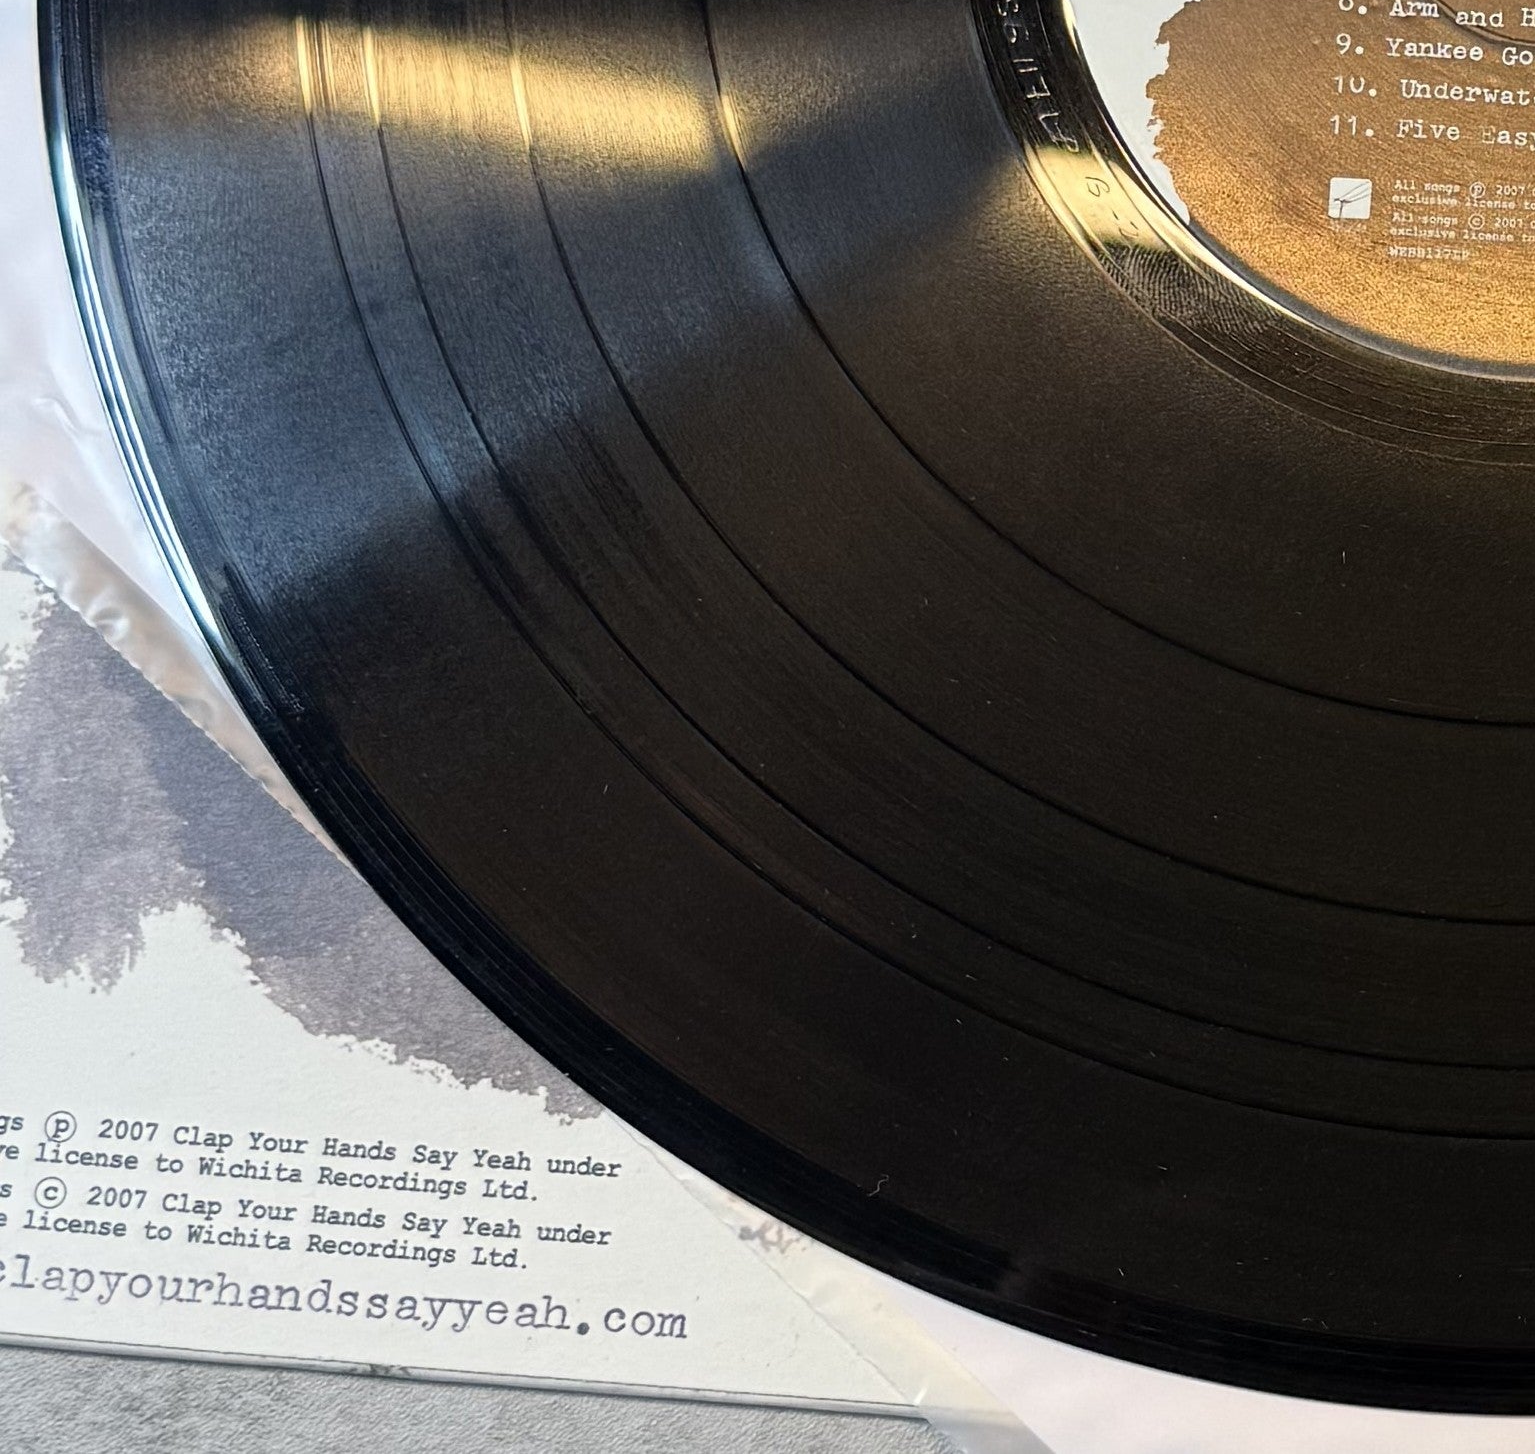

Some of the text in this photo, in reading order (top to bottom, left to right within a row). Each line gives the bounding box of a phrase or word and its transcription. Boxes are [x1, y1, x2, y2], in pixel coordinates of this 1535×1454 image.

[1455, 11, 1505, 28] and
[1336, 33, 1364, 55] 9.
[1385, 37, 1484, 62] Yankee
[1502, 46, 1534, 66] Go
[1330, 114, 1375, 138] 11.
[1396, 119, 1461, 141] Five
[1393, 180, 1416, 191] All
[1496, 185, 1526, 197] 2007
[1465, 198, 1516, 210] license
[1494, 217, 1524, 229] 2007
[98, 1118, 159, 1142] 2007
[173, 1126, 234, 1154] Clap
[249, 1131, 309, 1154] Your
[322, 1137, 397, 1162] Hands
[412, 1144, 459, 1172] Say
[473, 1148, 532, 1172] Yeah
[547, 1156, 623, 1178] under
[34, 1142, 139, 1170] license
[156, 1153, 184, 1174] to
[199, 1157, 303, 1184] Wichita
[317, 1166, 467, 1200] Recordings
[482, 1179, 537, 1202] Ltd.
[87, 1186, 147, 1210] 2007
[162, 1193, 222, 1221] Clap
[237, 1199, 298, 1222] Your
[311, 1205, 386, 1229] Hands
[402, 1212, 448, 1239] Say
[462, 1217, 521, 1240] Yeah
[536, 1225, 612, 1246] under
[22, 1209, 127, 1237] license
[144, 1221, 172, 1241] to
[187, 1224, 291, 1252] Wichita
[306, 1234, 456, 1268] Recordings
[471, 1246, 527, 1269] Ltd.
[0, 1253, 690, 1339] lapyourhandssayyeah.com
